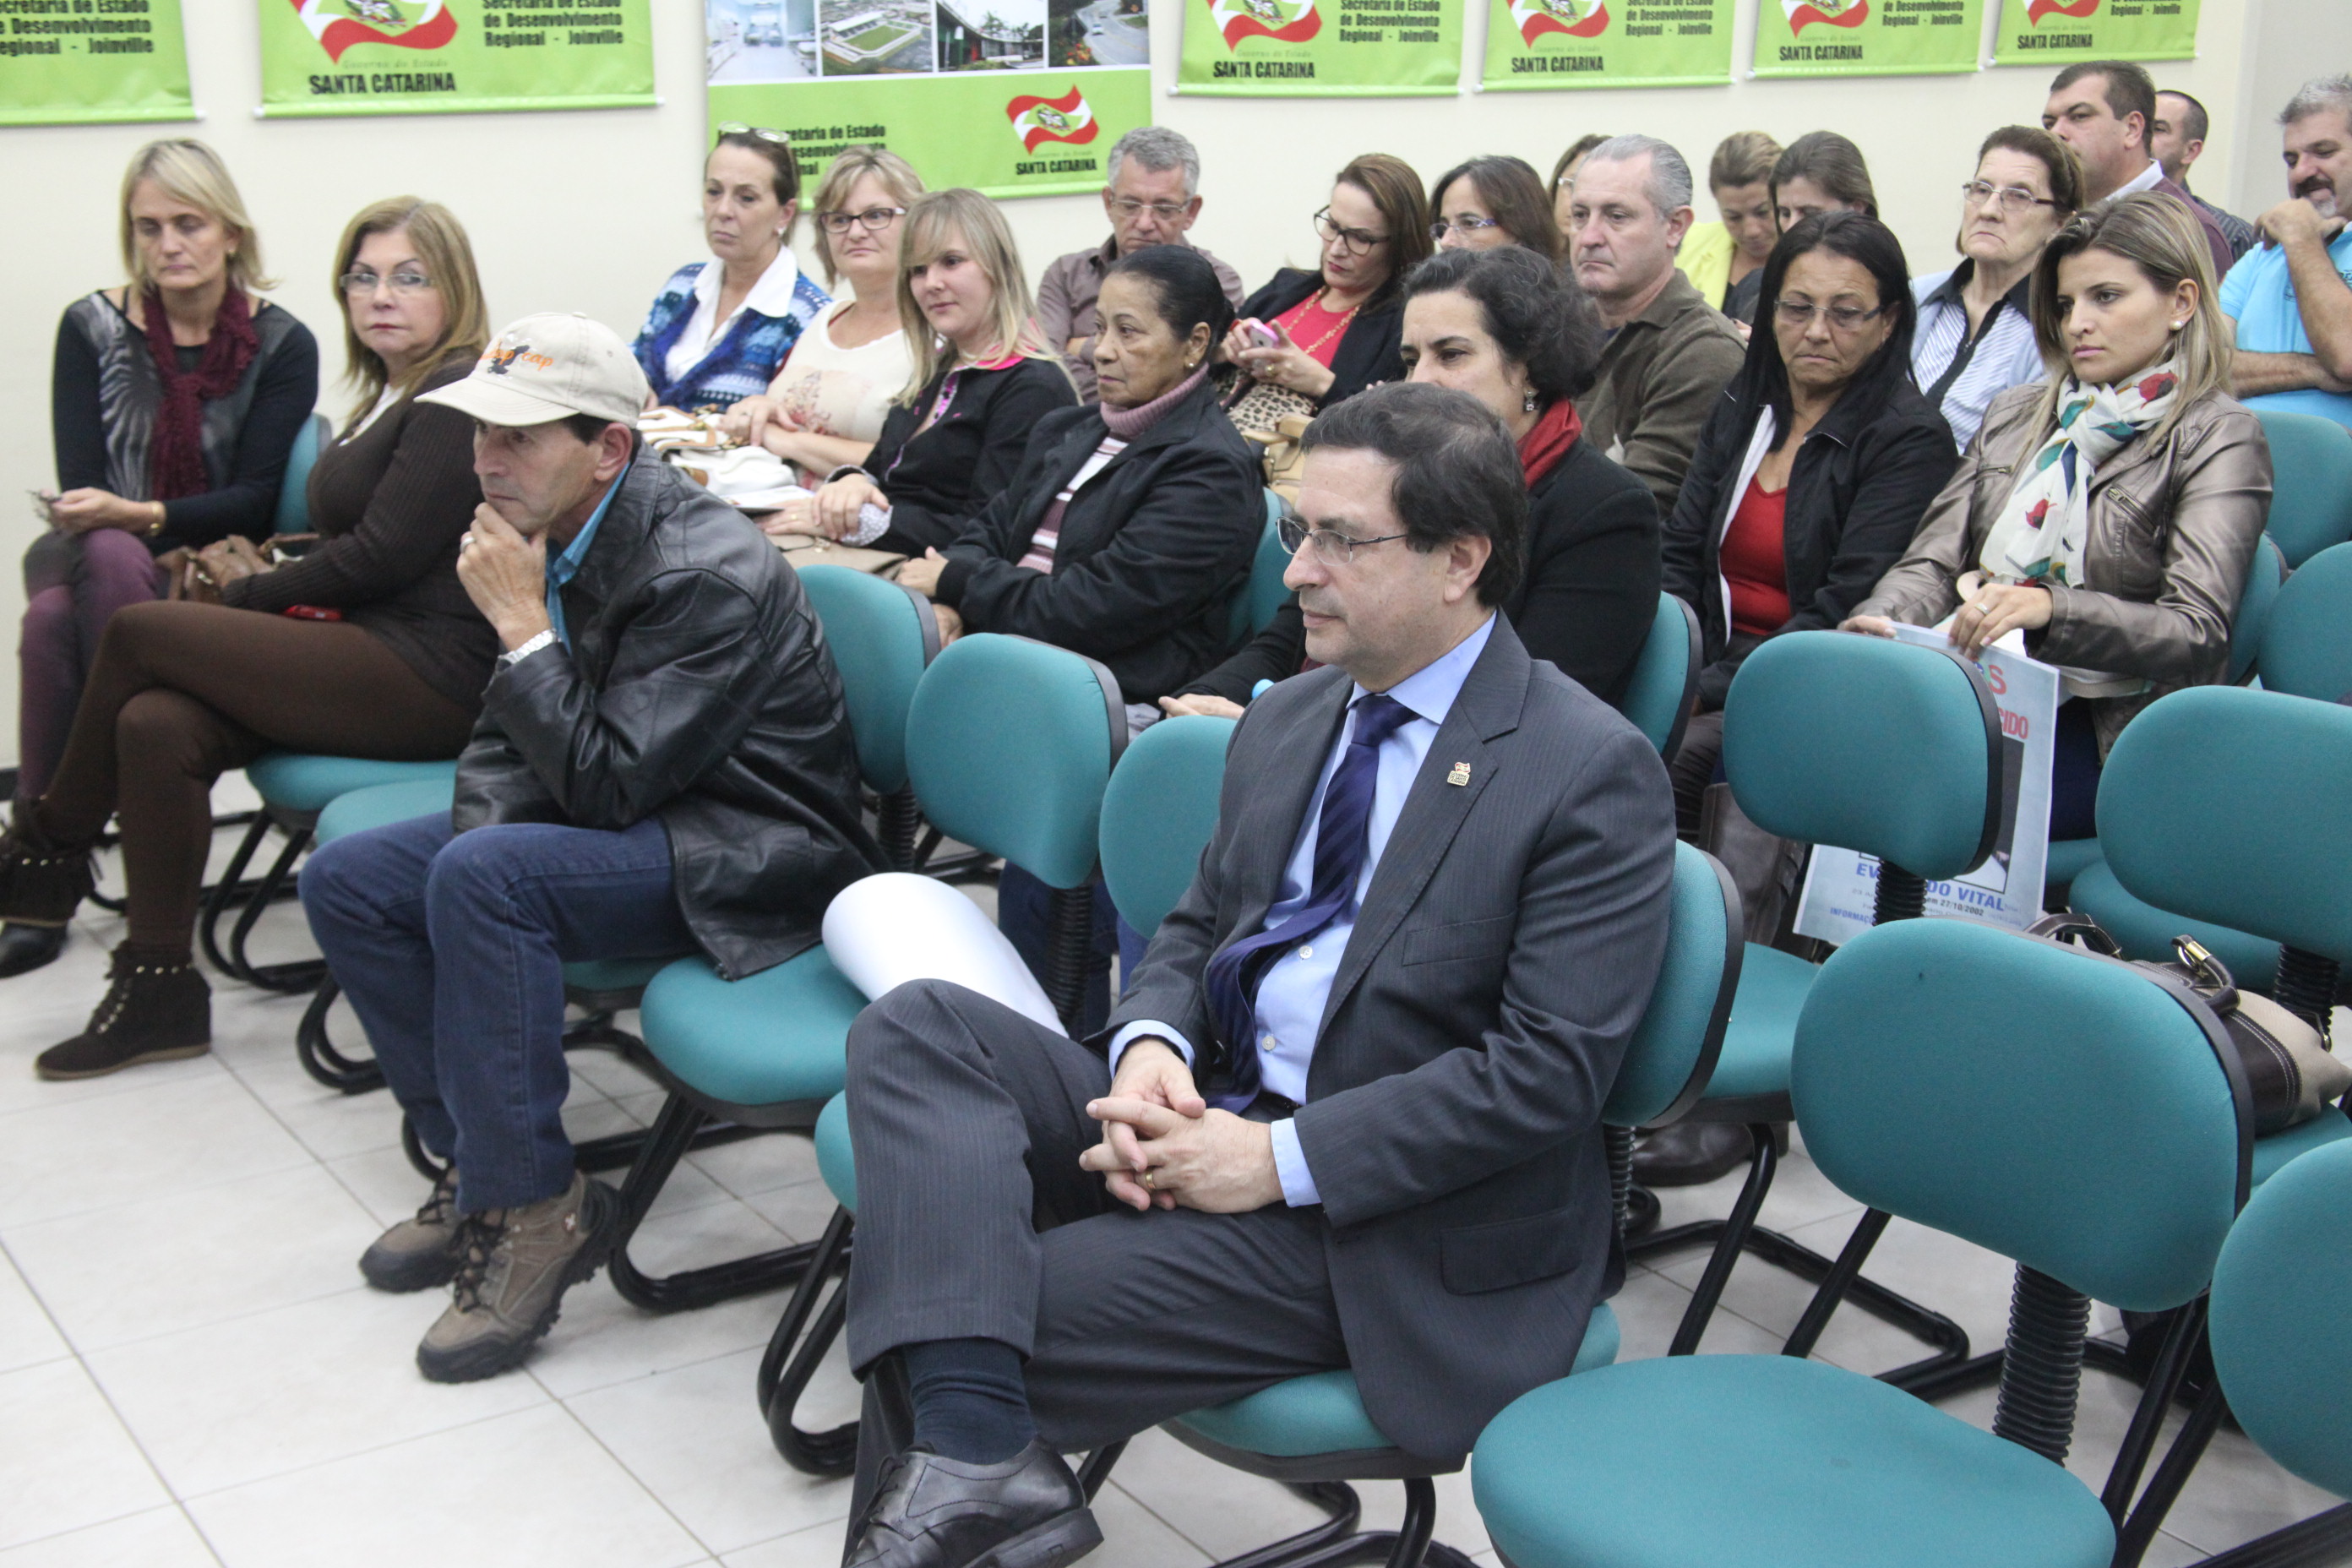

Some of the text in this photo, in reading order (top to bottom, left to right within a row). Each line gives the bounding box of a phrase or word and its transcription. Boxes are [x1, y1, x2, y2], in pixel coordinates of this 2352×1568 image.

[12, 18, 151, 34] Desenvolvimento
[484, 13, 623, 27] de Desenvolvimento
[1340, 14, 1440, 27] de Desenvolvimento
[485, 31, 546, 48] Regional
[569, 30, 623, 45] Joinville
[1340, 29, 1383, 43] Regional
[1398, 30, 1439, 42] Joinville
[2017, 34, 2093, 50] SANTA CATARINA
[88, 37, 154, 53] Joinville
[1779, 45, 1864, 62] SANTA CATARINA
[1213, 61, 1315, 78] SANTA CATARINA
[1511, 56, 1604, 74] SANTA CATARINA
[308, 72, 457, 95] SANTA CATARINA
[830, 125, 843, 139] de
[847, 124, 885, 138] Estado
[1016, 158, 1097, 176] SANTA CATARINA
[1957, 886, 2005, 912] VITAL
[1941, 901, 1984, 917] 27/10/2002
